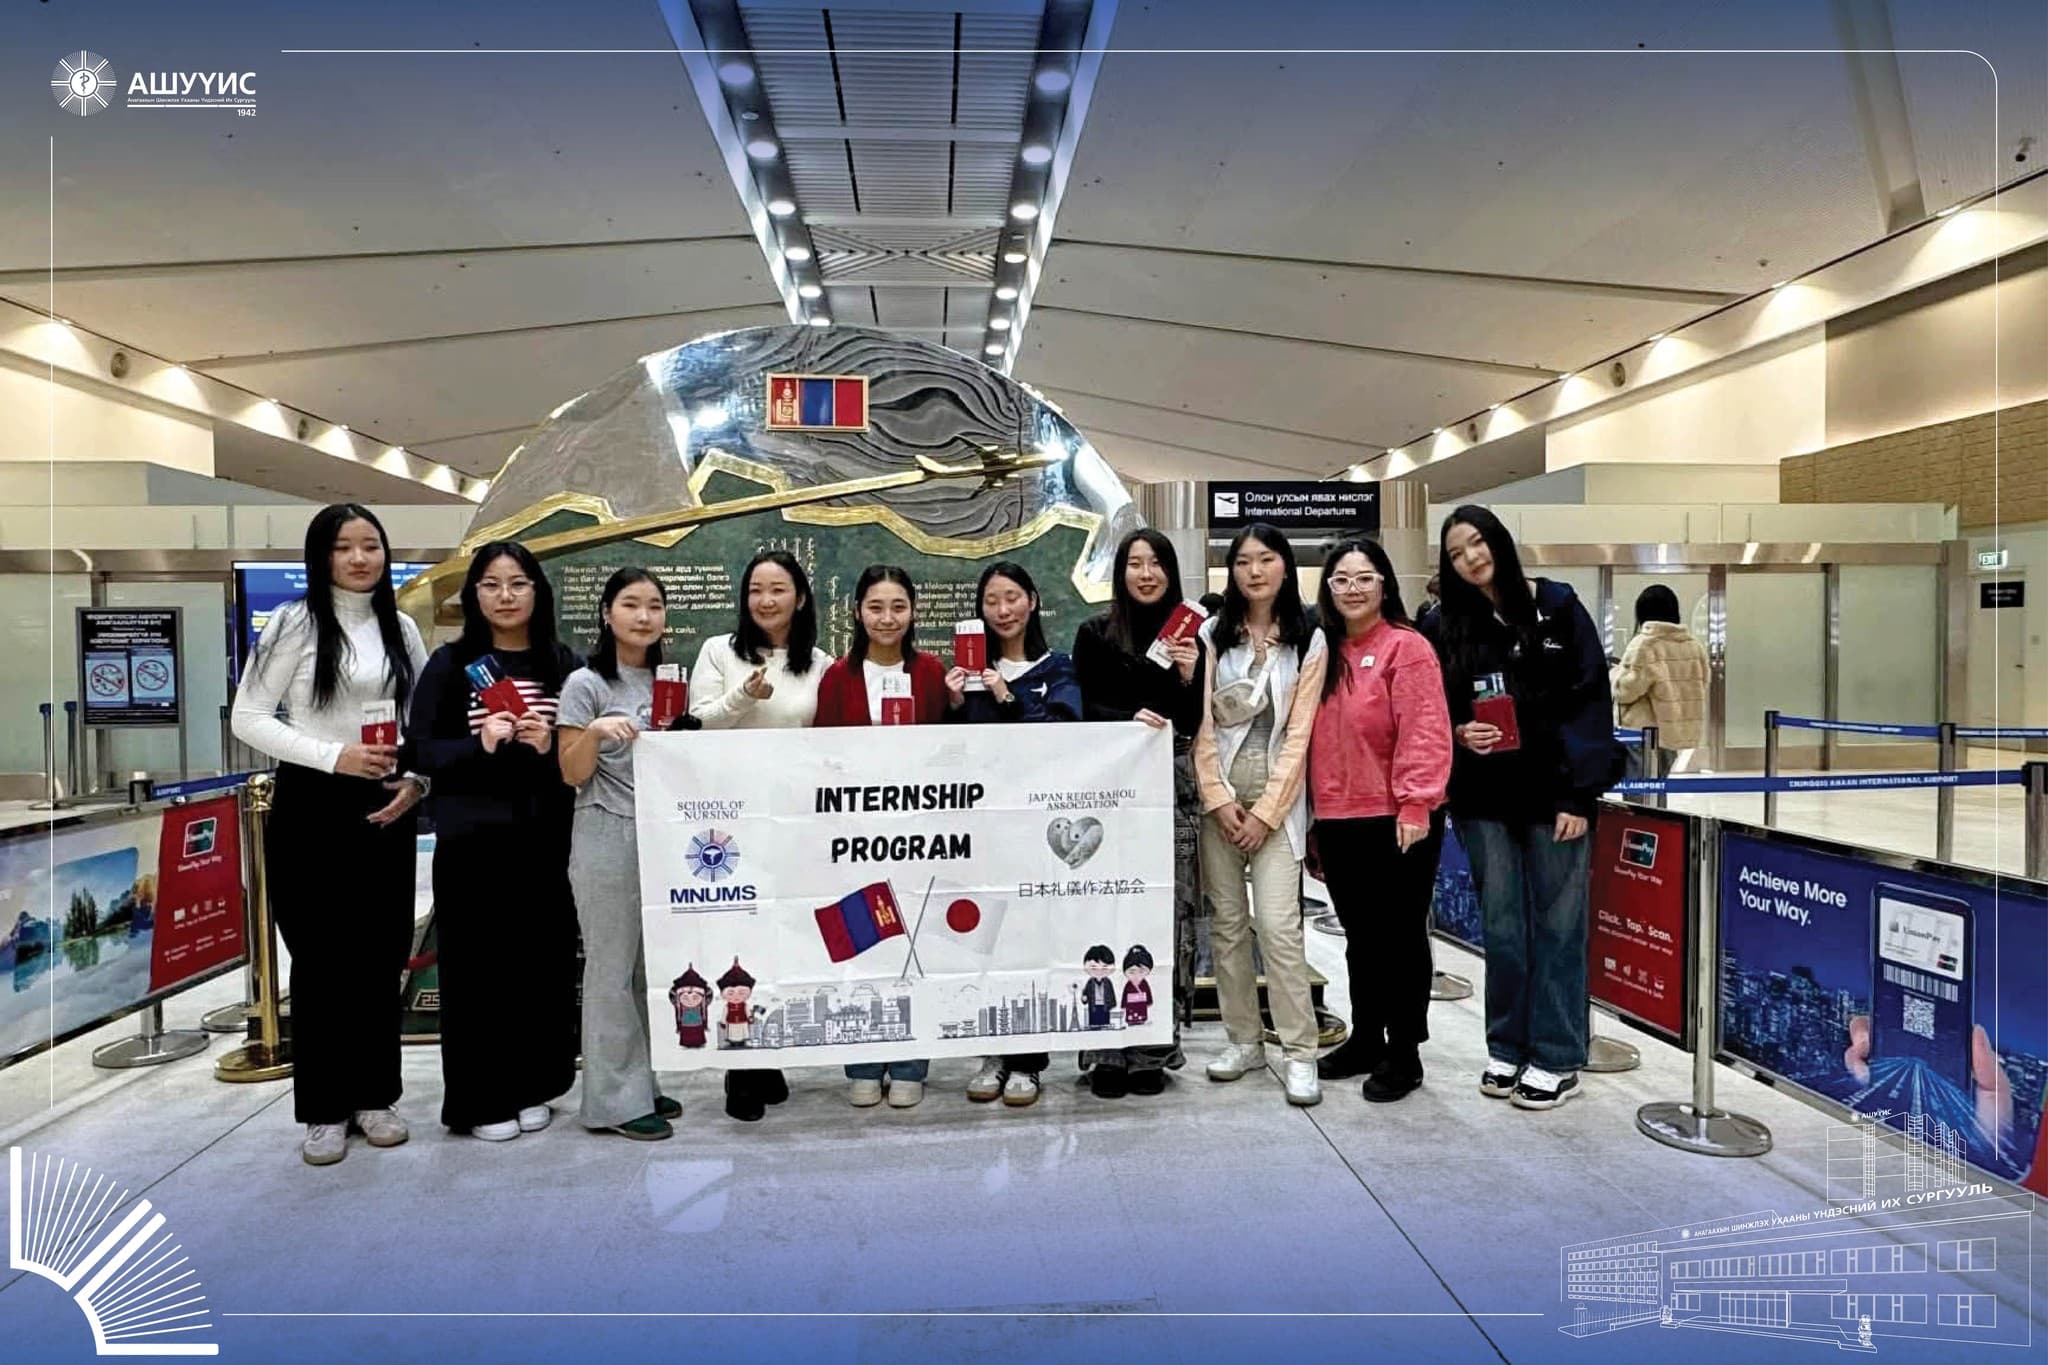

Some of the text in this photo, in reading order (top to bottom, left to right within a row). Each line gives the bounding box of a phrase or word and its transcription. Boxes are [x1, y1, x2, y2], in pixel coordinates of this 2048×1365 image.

[1245, 492, 1374, 504] Олон улсын явах нислэг
[1245, 507, 1356, 518] International Departures
[677, 800, 745, 811] SCHOOL OF
[815, 783, 984, 813] INTERNSHIP
[1028, 792, 1063, 805] JAPAN
[1066, 791, 1096, 801] REIGI
[1046, 800, 1119, 811] ASSOCIATION
[683, 810, 739, 820] NURSING
[831, 833, 971, 863] PROGRAM
[670, 885, 757, 904] MNUMS
[1018, 878, 1146, 898] 日本礼儀作法協会
[1739, 866, 1848, 908] Achieve More
[1739, 888, 1812, 926] Your Way.
[1648, 925, 1673, 942] Scan.
